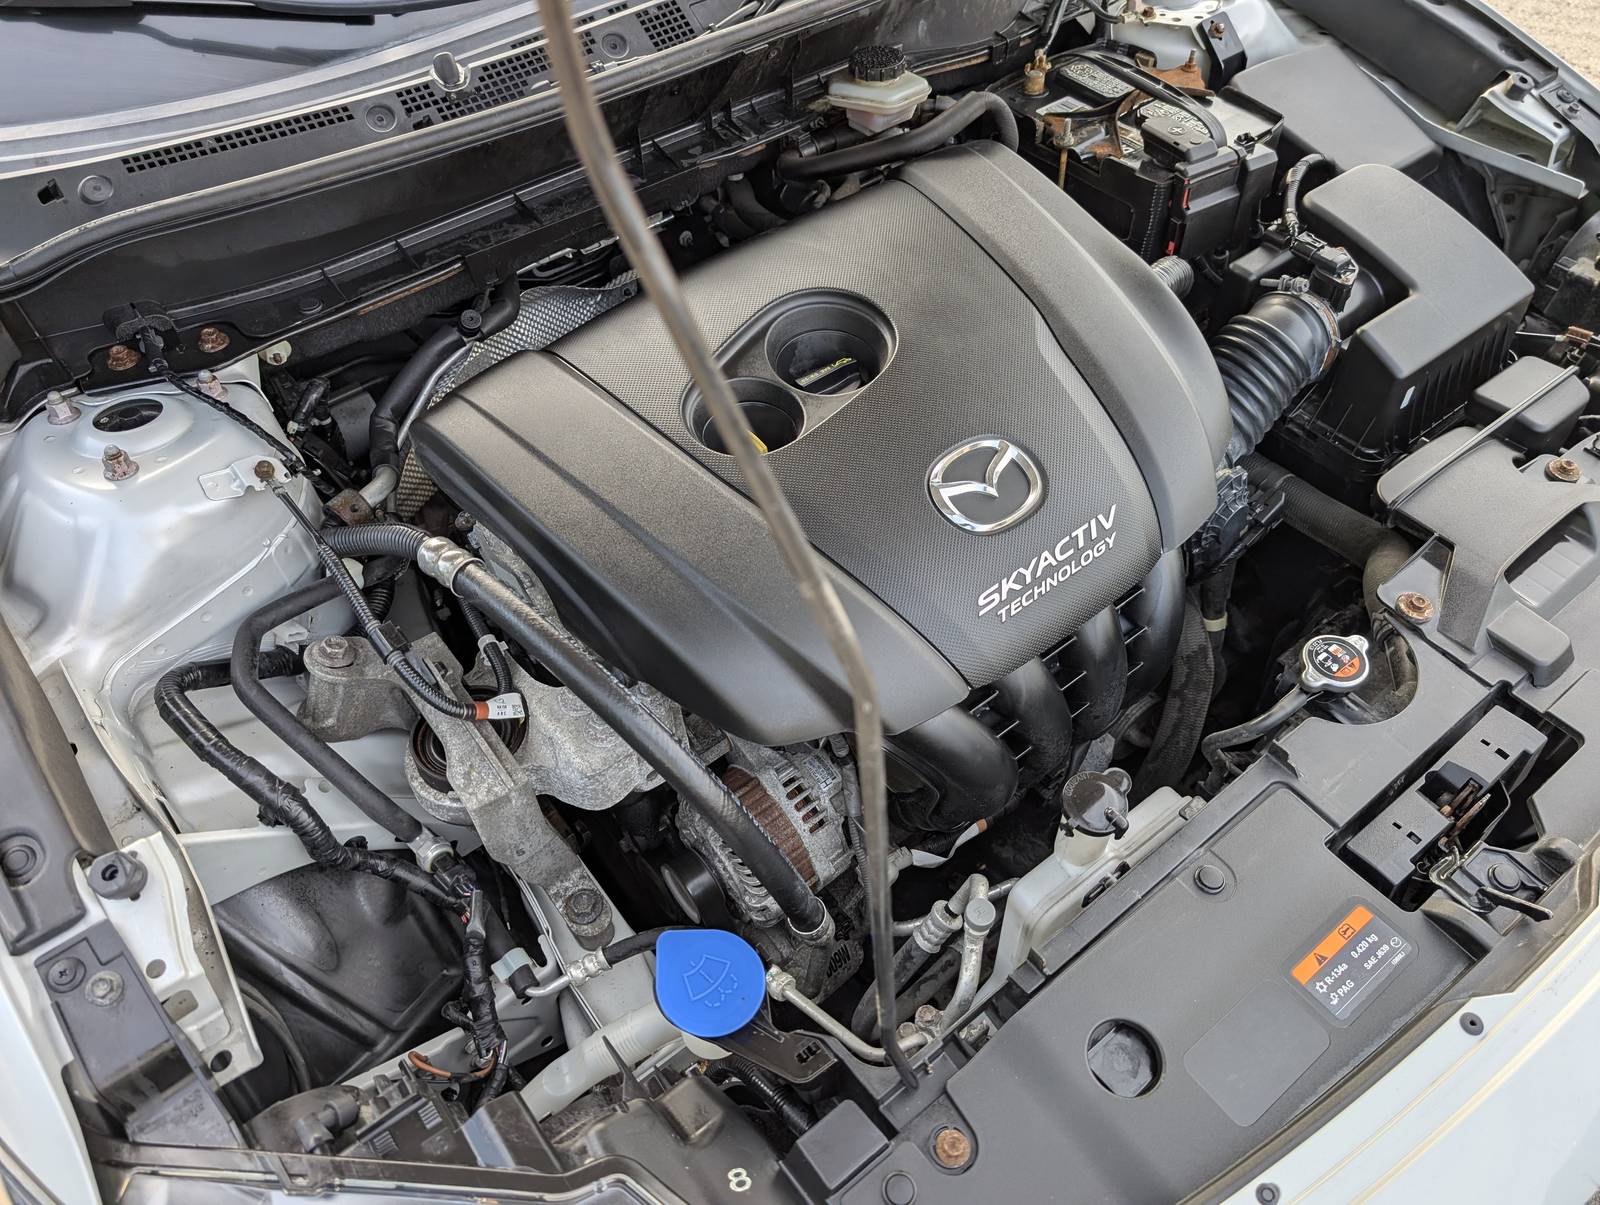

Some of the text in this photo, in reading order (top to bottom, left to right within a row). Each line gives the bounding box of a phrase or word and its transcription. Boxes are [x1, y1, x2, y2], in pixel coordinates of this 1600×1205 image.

[978, 503, 1116, 617] SKYACTIV
[997, 531, 1116, 623] TECHNOLOGY
[1324, 933, 1379, 986] R-134a 0.420 kg
[1337, 944, 1390, 997] PAG SAE J639
[728, 1168, 752, 1192] 8
